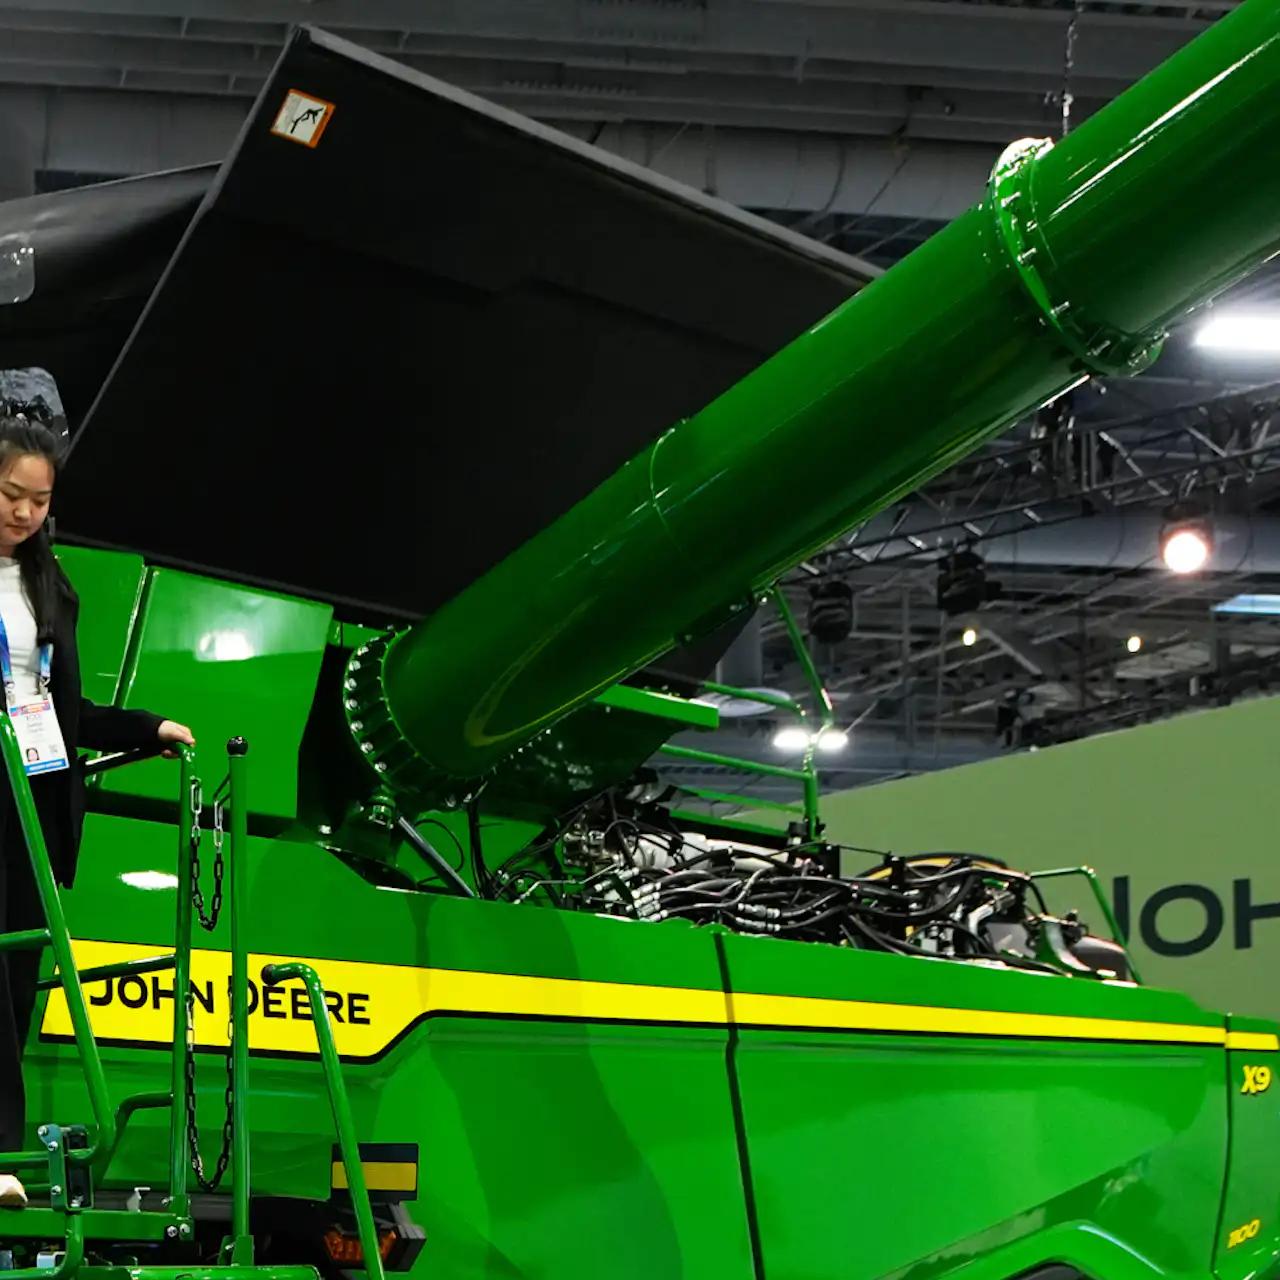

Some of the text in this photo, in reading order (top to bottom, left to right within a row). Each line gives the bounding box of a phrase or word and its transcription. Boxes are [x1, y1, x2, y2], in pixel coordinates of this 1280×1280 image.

[90, 974, 371, 1026] JOHN DEERE
[1240, 1064, 1272, 1095] X9
